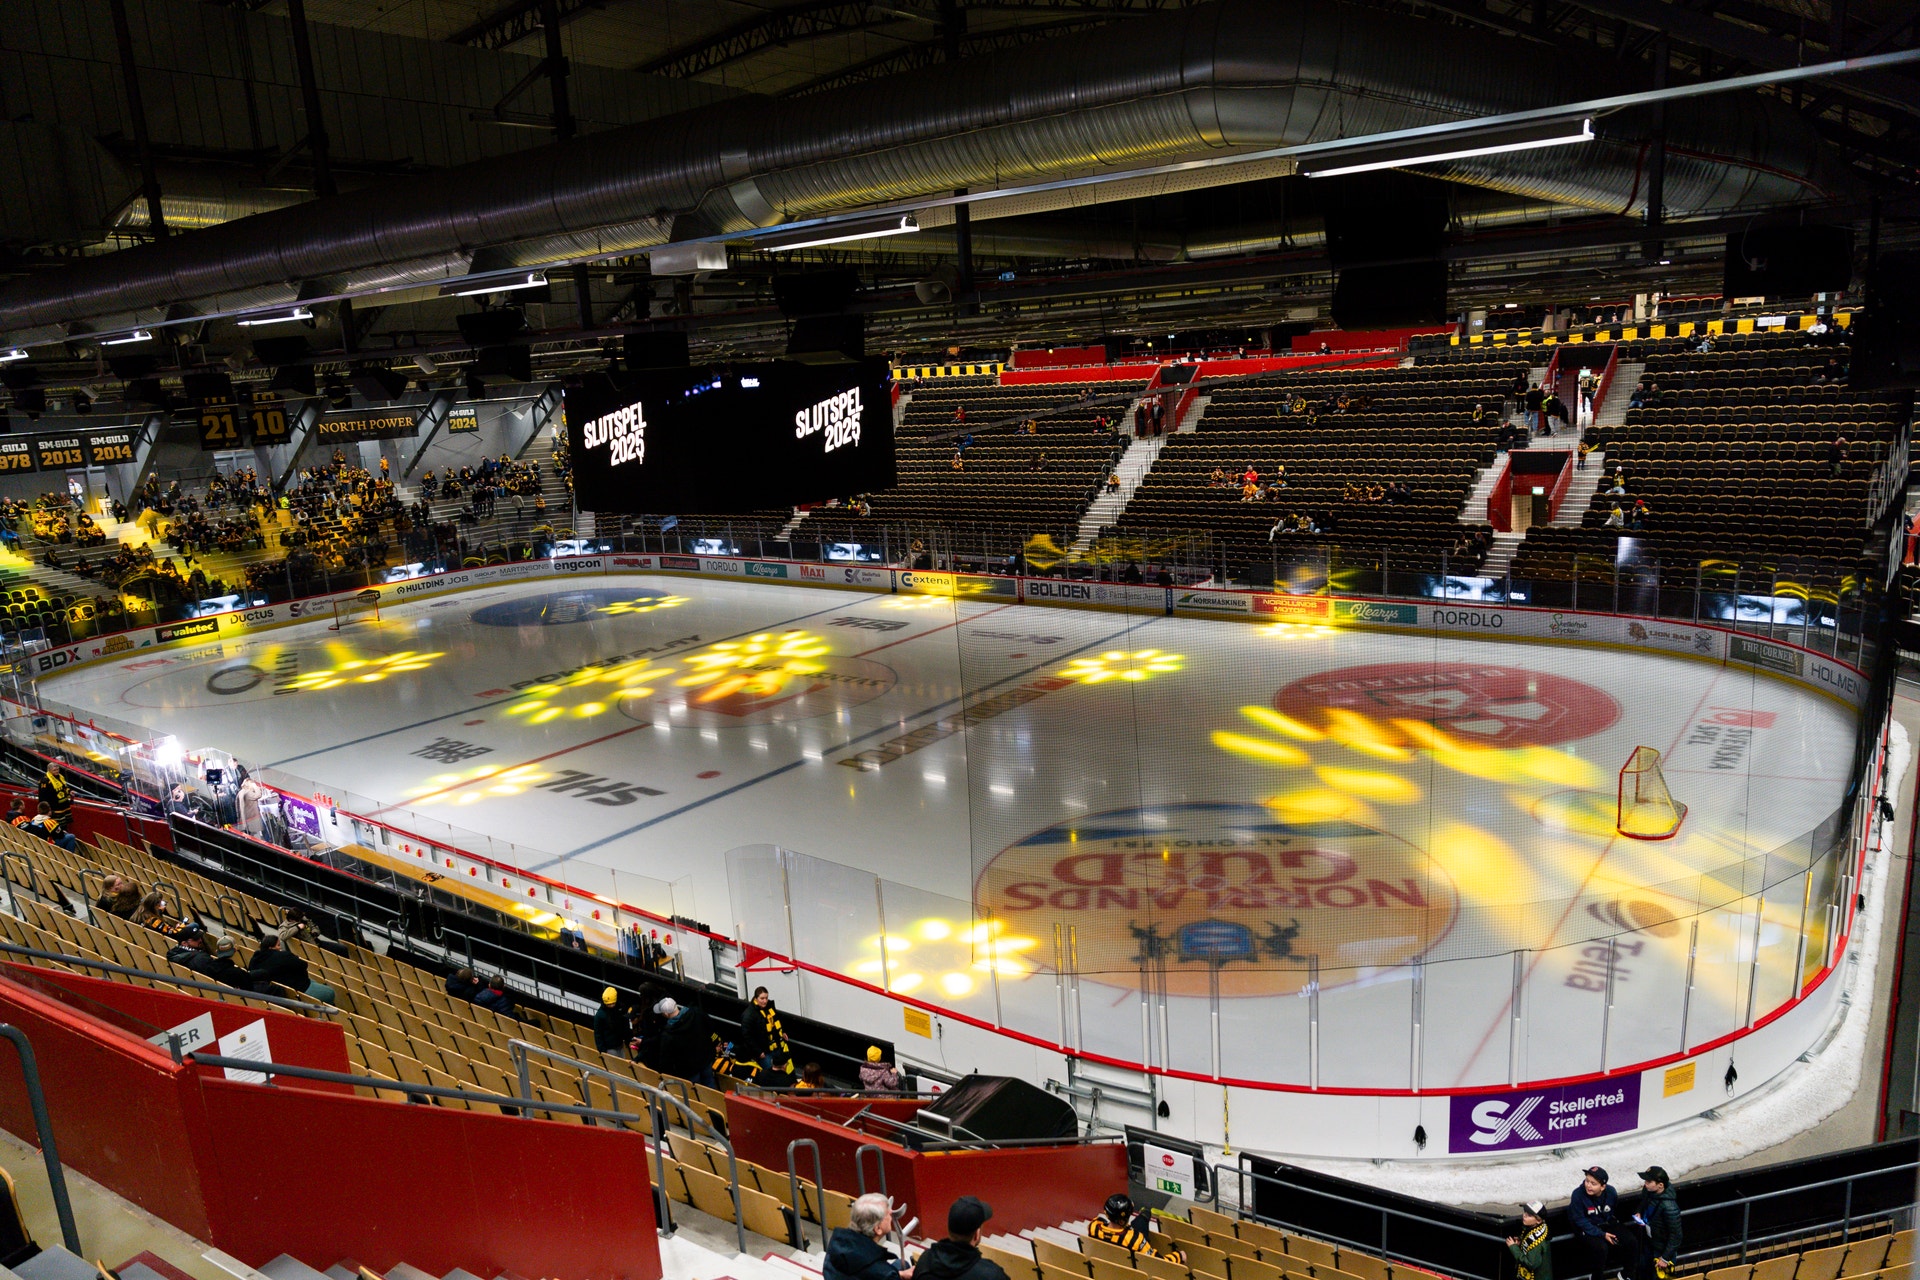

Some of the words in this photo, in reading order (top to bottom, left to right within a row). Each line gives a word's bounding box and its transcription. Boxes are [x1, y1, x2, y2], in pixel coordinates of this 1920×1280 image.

[796, 386, 864, 439] SLUTSPEL
[202, 414, 238, 440] 21
[252, 411, 285, 436] 10
[319, 419, 367, 434] NORTH
[370, 416, 414, 430] POWER
[449, 416, 478, 430] 2024
[584, 401, 647, 449] SLUTSPEL
[90, 435, 130, 446] SM-GULD
[825, 412, 862, 453] 2025
[38, 439, 80, 450] SM-GULD
[93, 445, 133, 461] 2014
[610, 428, 645, 466] 2025
[41, 449, 82, 466] 2013
[500, 562, 549, 574] MARTINSONS
[554, 558, 601, 571] engcon
[406, 579, 445, 593] HULTDINS
[913, 577, 950, 586] extena
[1030, 582, 1091, 600] BOLIDEN
[1193, 597, 1247, 607] NORRMASKINER
[1263, 599, 1318, 608] NORDLUNDS
[1274, 606, 1306, 614] MOTOR
[230, 609, 274, 625] Ductus
[1350, 603, 1399, 622] O'Learys
[173, 622, 214, 637] valutec
[38, 647, 81, 671] BDX
[1762, 646, 1795, 663] CORNER
[1811, 661, 1861, 696] HOLMEN
[535, 769, 669, 807] SHL
[1052, 848, 1359, 888] GULD
[1002, 877, 1434, 913] NORRLANDS
[1563, 938, 1646, 993] Telia
[1549, 1088, 1625, 1115] Skellefteå
[1469, 1095, 1545, 1146] SK
[1548, 1114, 1588, 1131] Kraft
[1162, 1156, 1175, 1165] STOP
